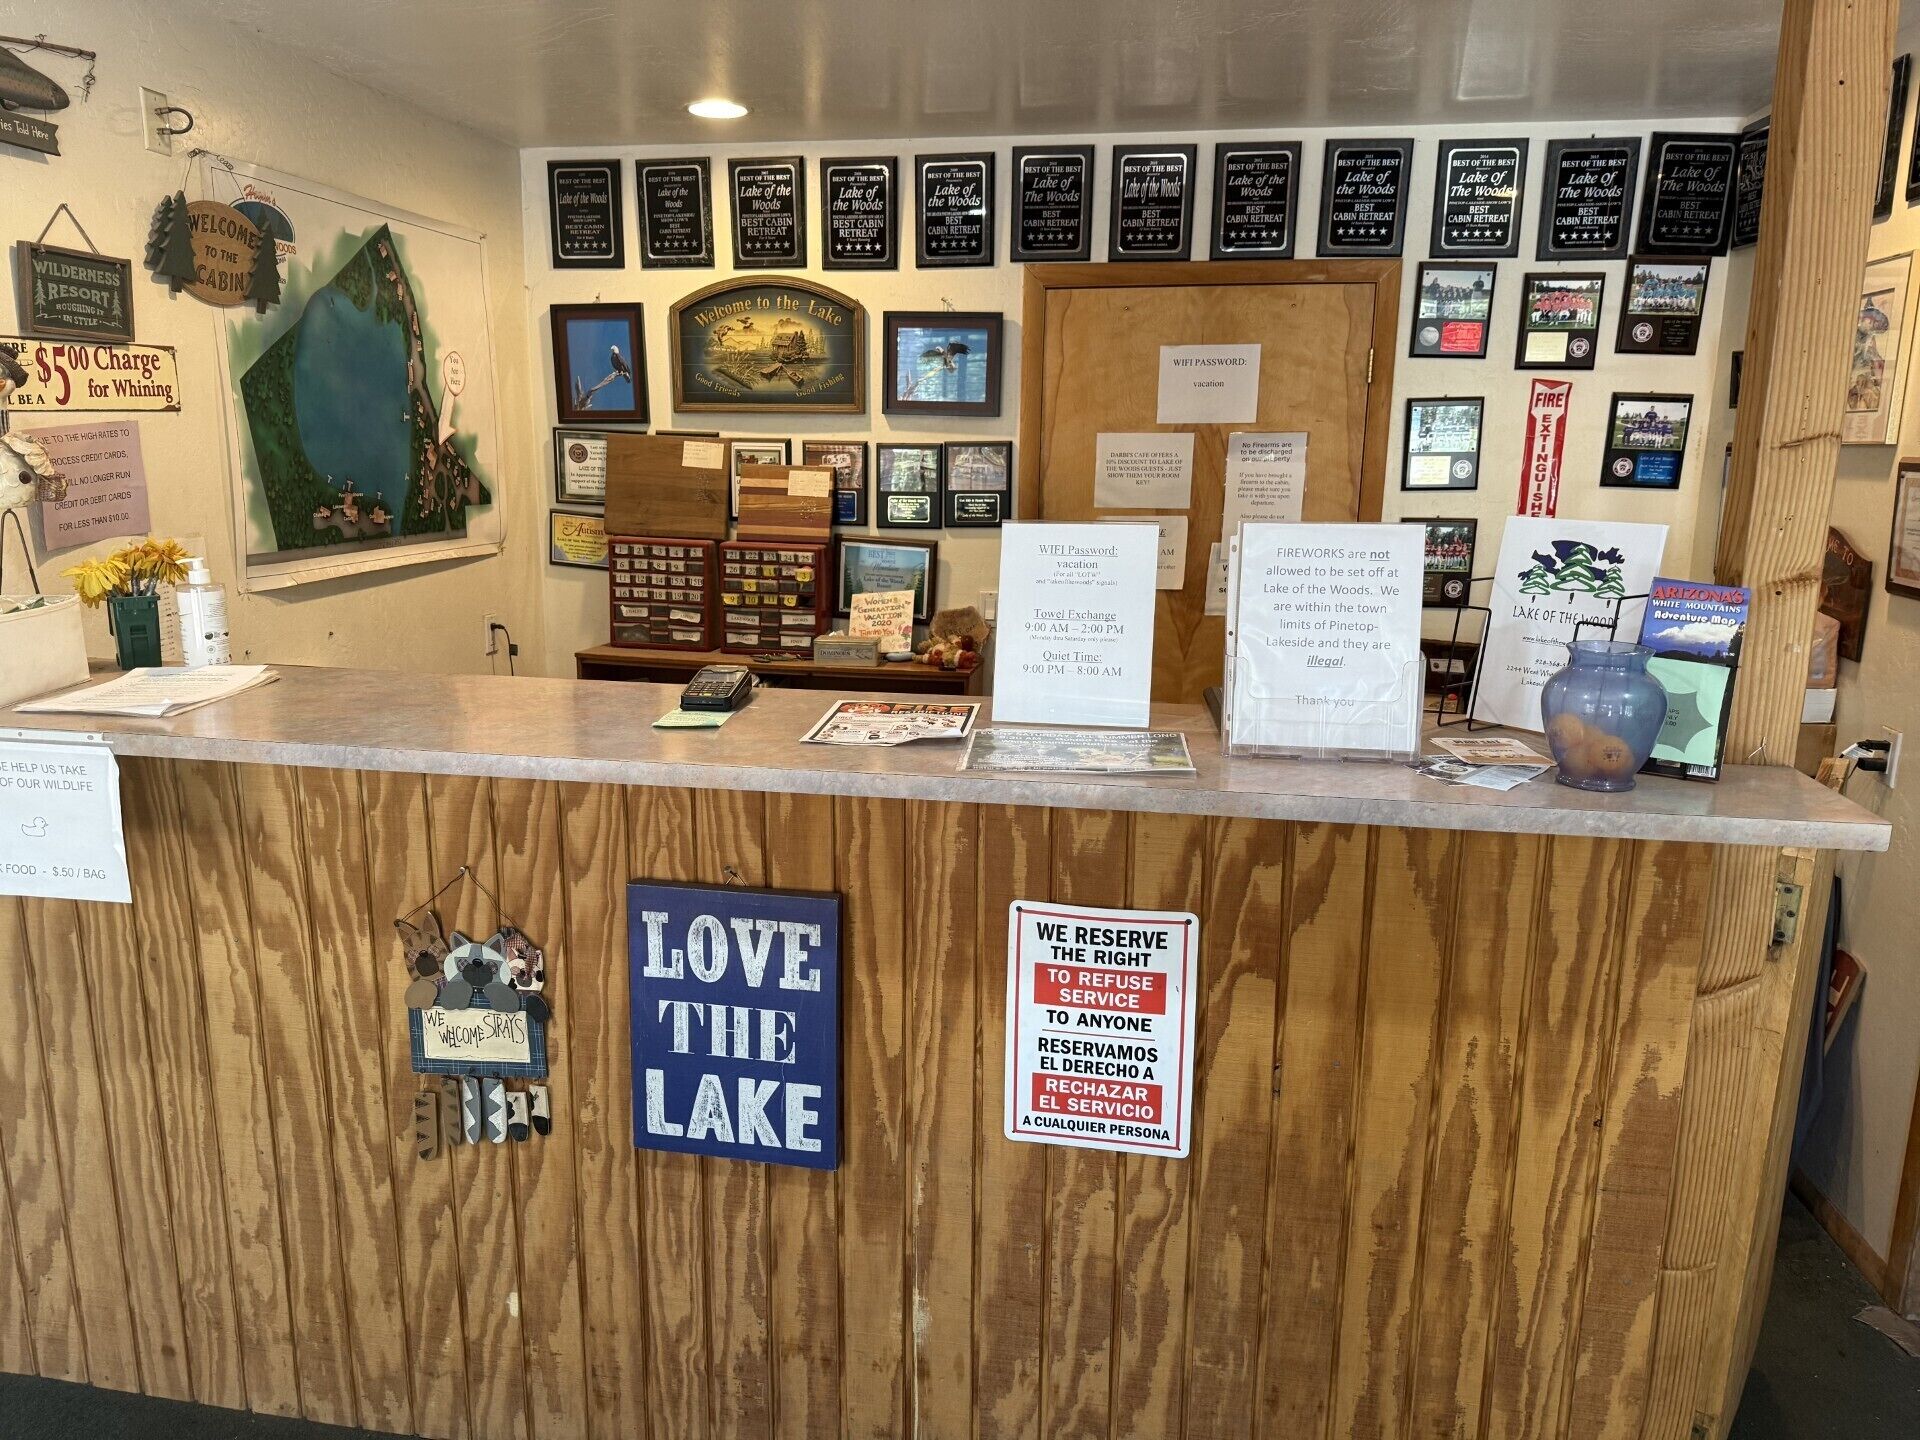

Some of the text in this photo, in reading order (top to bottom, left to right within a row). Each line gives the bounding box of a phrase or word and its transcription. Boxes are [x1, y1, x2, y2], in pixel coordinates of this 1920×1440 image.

[14, 120, 49, 140] Told Here
[1561, 160, 1580, 168] BEST
[1568, 171, 1619, 186] Lake Of
[1559, 185, 1623, 198] The Woods
[1578, 207, 1599, 216] BEST
[1556, 216, 1619, 226] CABIN RETREAT
[188, 214, 258, 249] WELCOME
[205, 245, 239, 264] TO THE
[32, 259, 120, 287] WILDERNESS
[196, 264, 245, 292] CABIN
[48, 282, 110, 308] RESORT
[56, 303, 96, 314] ROUGHING
[694, 295, 842, 329] Welcome to the Lake
[63, 314, 98, 326] IN STYLE
[94, 346, 161, 380] Charge
[1173, 358, 1248, 367] WIFI PASSWORD:
[695, 372, 741, 398] Good Friends
[818, 372, 845, 391] Fishing
[1193, 379, 1225, 388] vacation
[88, 378, 173, 403] for Whining
[18, 394, 33, 405] BE
[36, 394, 46, 405] A
[1534, 392, 1564, 408] FIRE
[52, 428, 130, 444] TO THE HIGH RATES TO
[81, 450, 129, 463] CREDIT CARDS,
[1531, 413, 1553, 518] EXTINGUISHE
[54, 491, 132, 511] CREDIT OR DEBIT CARDS
[58, 512, 129, 532] FOR LESS THAN $10.00
[1038, 544, 1118, 556] WIFI Password:
[1276, 547, 1390, 560] FIREWORKS are not
[1057, 559, 1098, 569] vacation
[1266, 566, 1399, 578] allowed to be set off at
[1263, 583, 1400, 596] Lake of the Woods. We
[1652, 585, 1745, 604] ARIZONA'S
[1033, 608, 1117, 622] Towel Exchange
[1273, 601, 1388, 614] are within the town
[1652, 599, 1742, 614] WHITE MOUNTAINS
[1512, 605, 1615, 629] LAKE OF THE WOOD
[1654, 610, 1737, 627] Adventure Map
[1024, 621, 1125, 634] 9:00 AM 2:00 PM
[1279, 619, 1379, 633] limits of Pinetop-
[1266, 637, 1391, 652] Lakeside and they are
[1042, 650, 1102, 662] Quiet Time:
[1306, 655, 1347, 668] illegal.
[1022, 664, 1122, 677] 9:00 PM 8:00 AM
[1295, 694, 1355, 708] Thank you
[10, 762, 39, 773] HELP
[40, 763, 57, 774] US
[58, 765, 88, 776] TAKE
[0, 776, 94, 792] OF OUR WILDLIFE
[5, 863, 107, 880] FOOD $.50 BAG
[1036, 922, 1169, 950] WE RESERVE
[642, 910, 821, 992] LOVE
[1050, 945, 1152, 968] THE RIGHT
[1047, 968, 1154, 991] TO REFUSE
[1059, 988, 1140, 1009] SERVICE
[425, 1010, 526, 1049] WE WELCOME STRAYS
[1046, 1009, 1153, 1033] TO ANYONE
[658, 999, 796, 1064] THE
[1038, 1037, 1159, 1063] RESERVAMOS
[1040, 1056, 1155, 1081] EL DERECHO A
[1045, 1078, 1148, 1102] RECHAZAR
[645, 1068, 822, 1153] LAKE
[1039, 1095, 1154, 1120] EL SERVICIO
[1022, 1115, 1171, 1141] A CUALQUIER PERSONA
